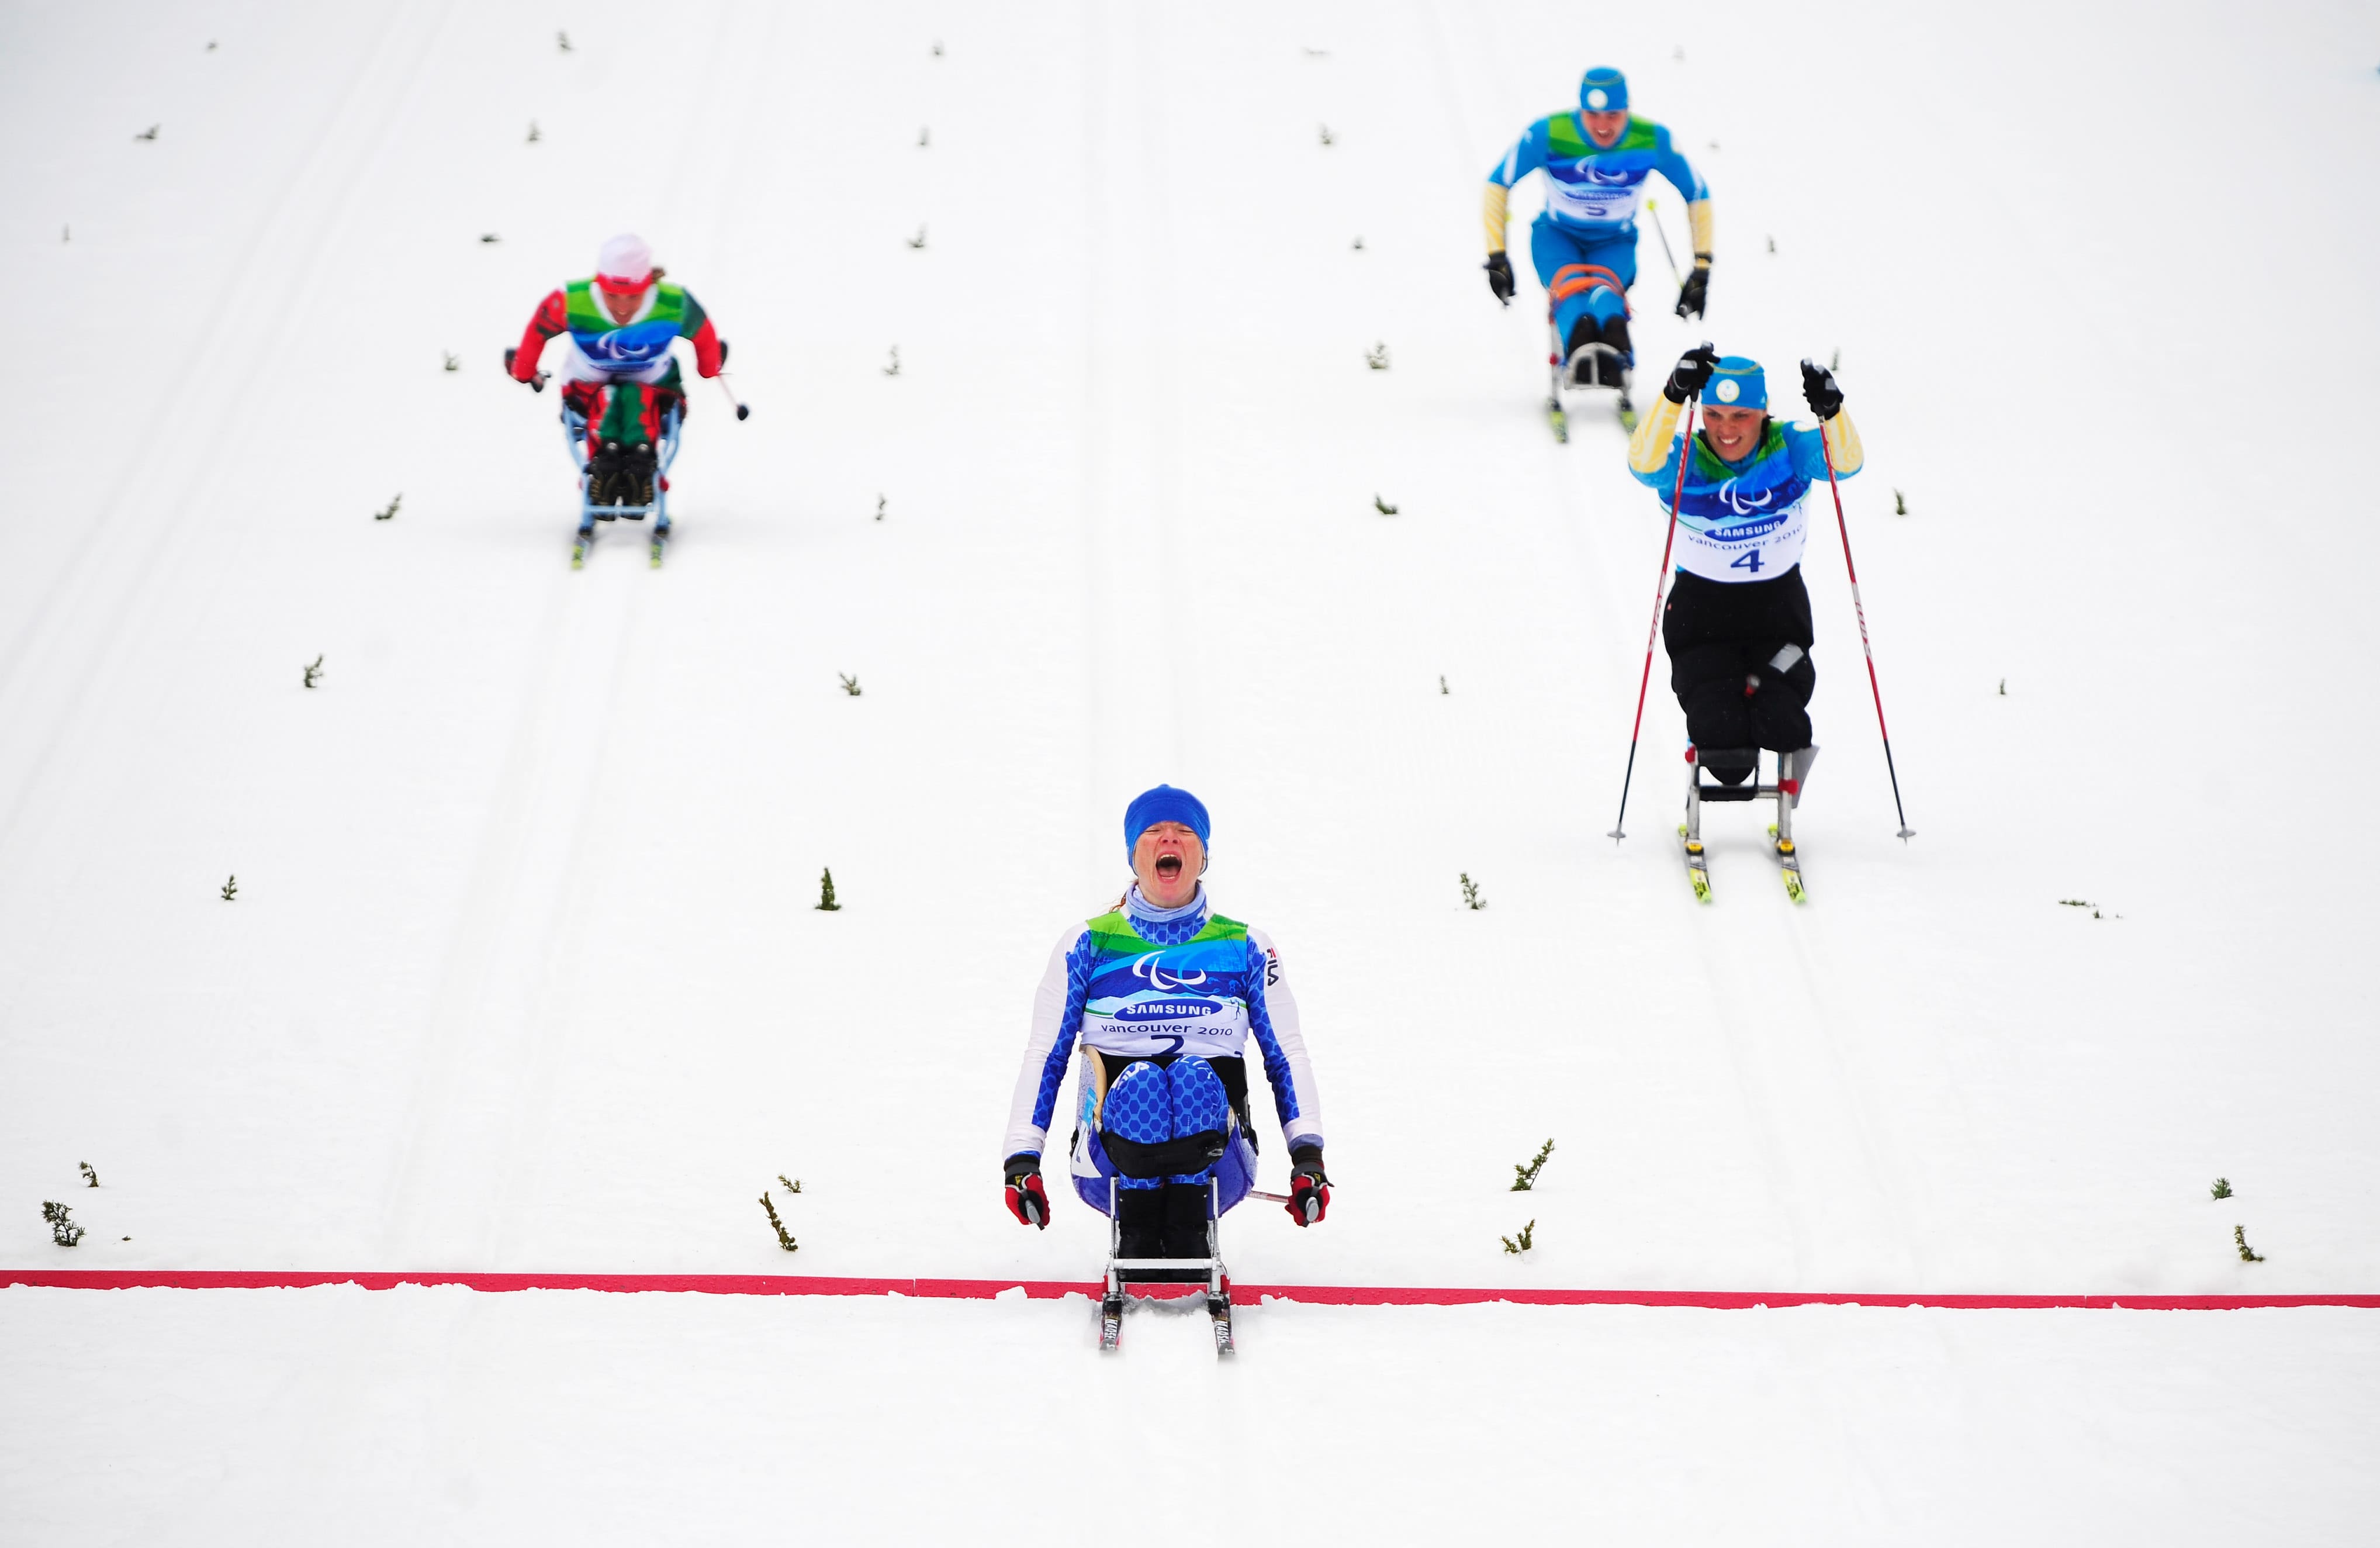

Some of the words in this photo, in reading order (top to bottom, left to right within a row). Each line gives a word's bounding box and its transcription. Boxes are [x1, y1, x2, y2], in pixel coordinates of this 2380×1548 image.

[1715, 520, 1781, 537] SAMSUNG
[1688, 534, 1769, 550] vancouver
[1730, 549, 1765, 572] 4
[1267, 948, 1279, 986] FILA
[1126, 1004, 1212, 1015] SAMSUNG
[1101, 1024, 1192, 1033] vancouver
[1197, 1027, 1233, 1036] 2010
[1151, 1035, 1184, 1056] 2
